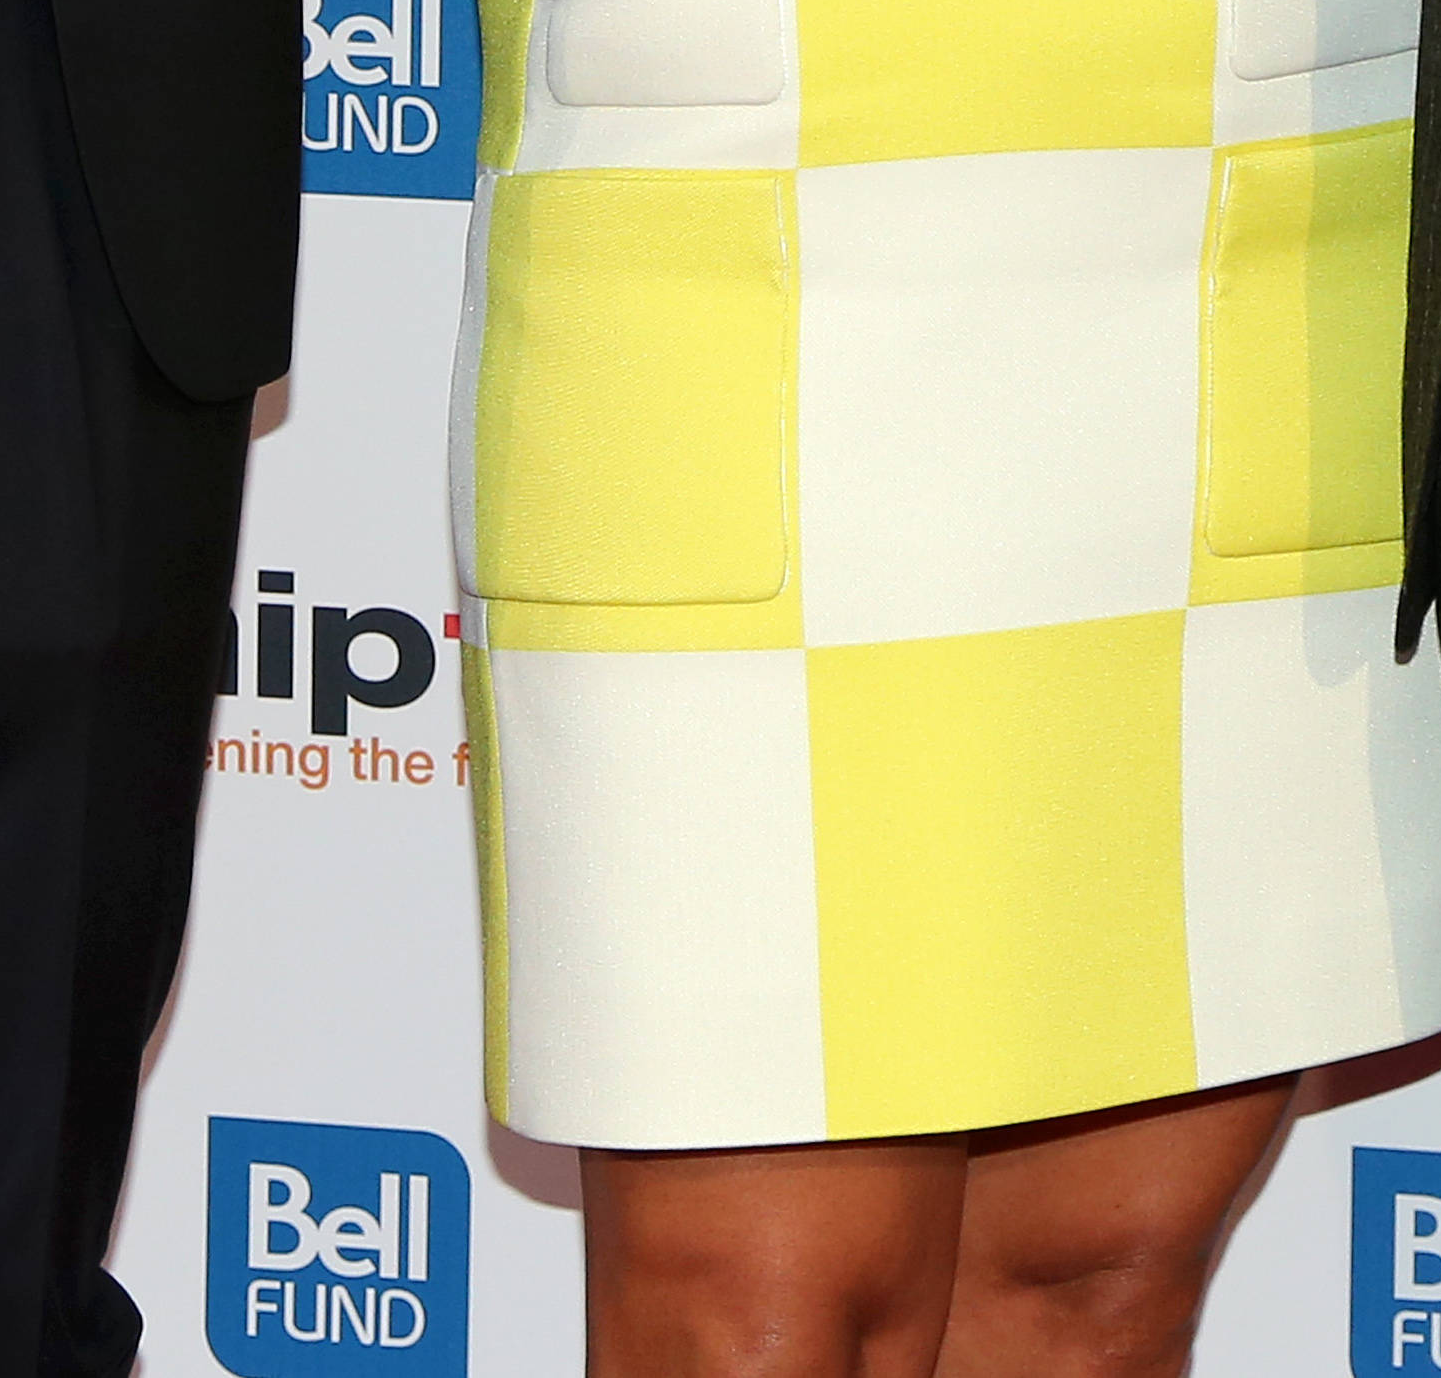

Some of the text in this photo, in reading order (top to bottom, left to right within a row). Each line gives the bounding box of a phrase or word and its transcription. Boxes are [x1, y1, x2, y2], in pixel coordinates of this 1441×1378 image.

[302, 92, 438, 154] UND
[348, 736, 435, 785] the
[248, 1162, 429, 1282] Bell
[246, 1279, 428, 1347] FUND
